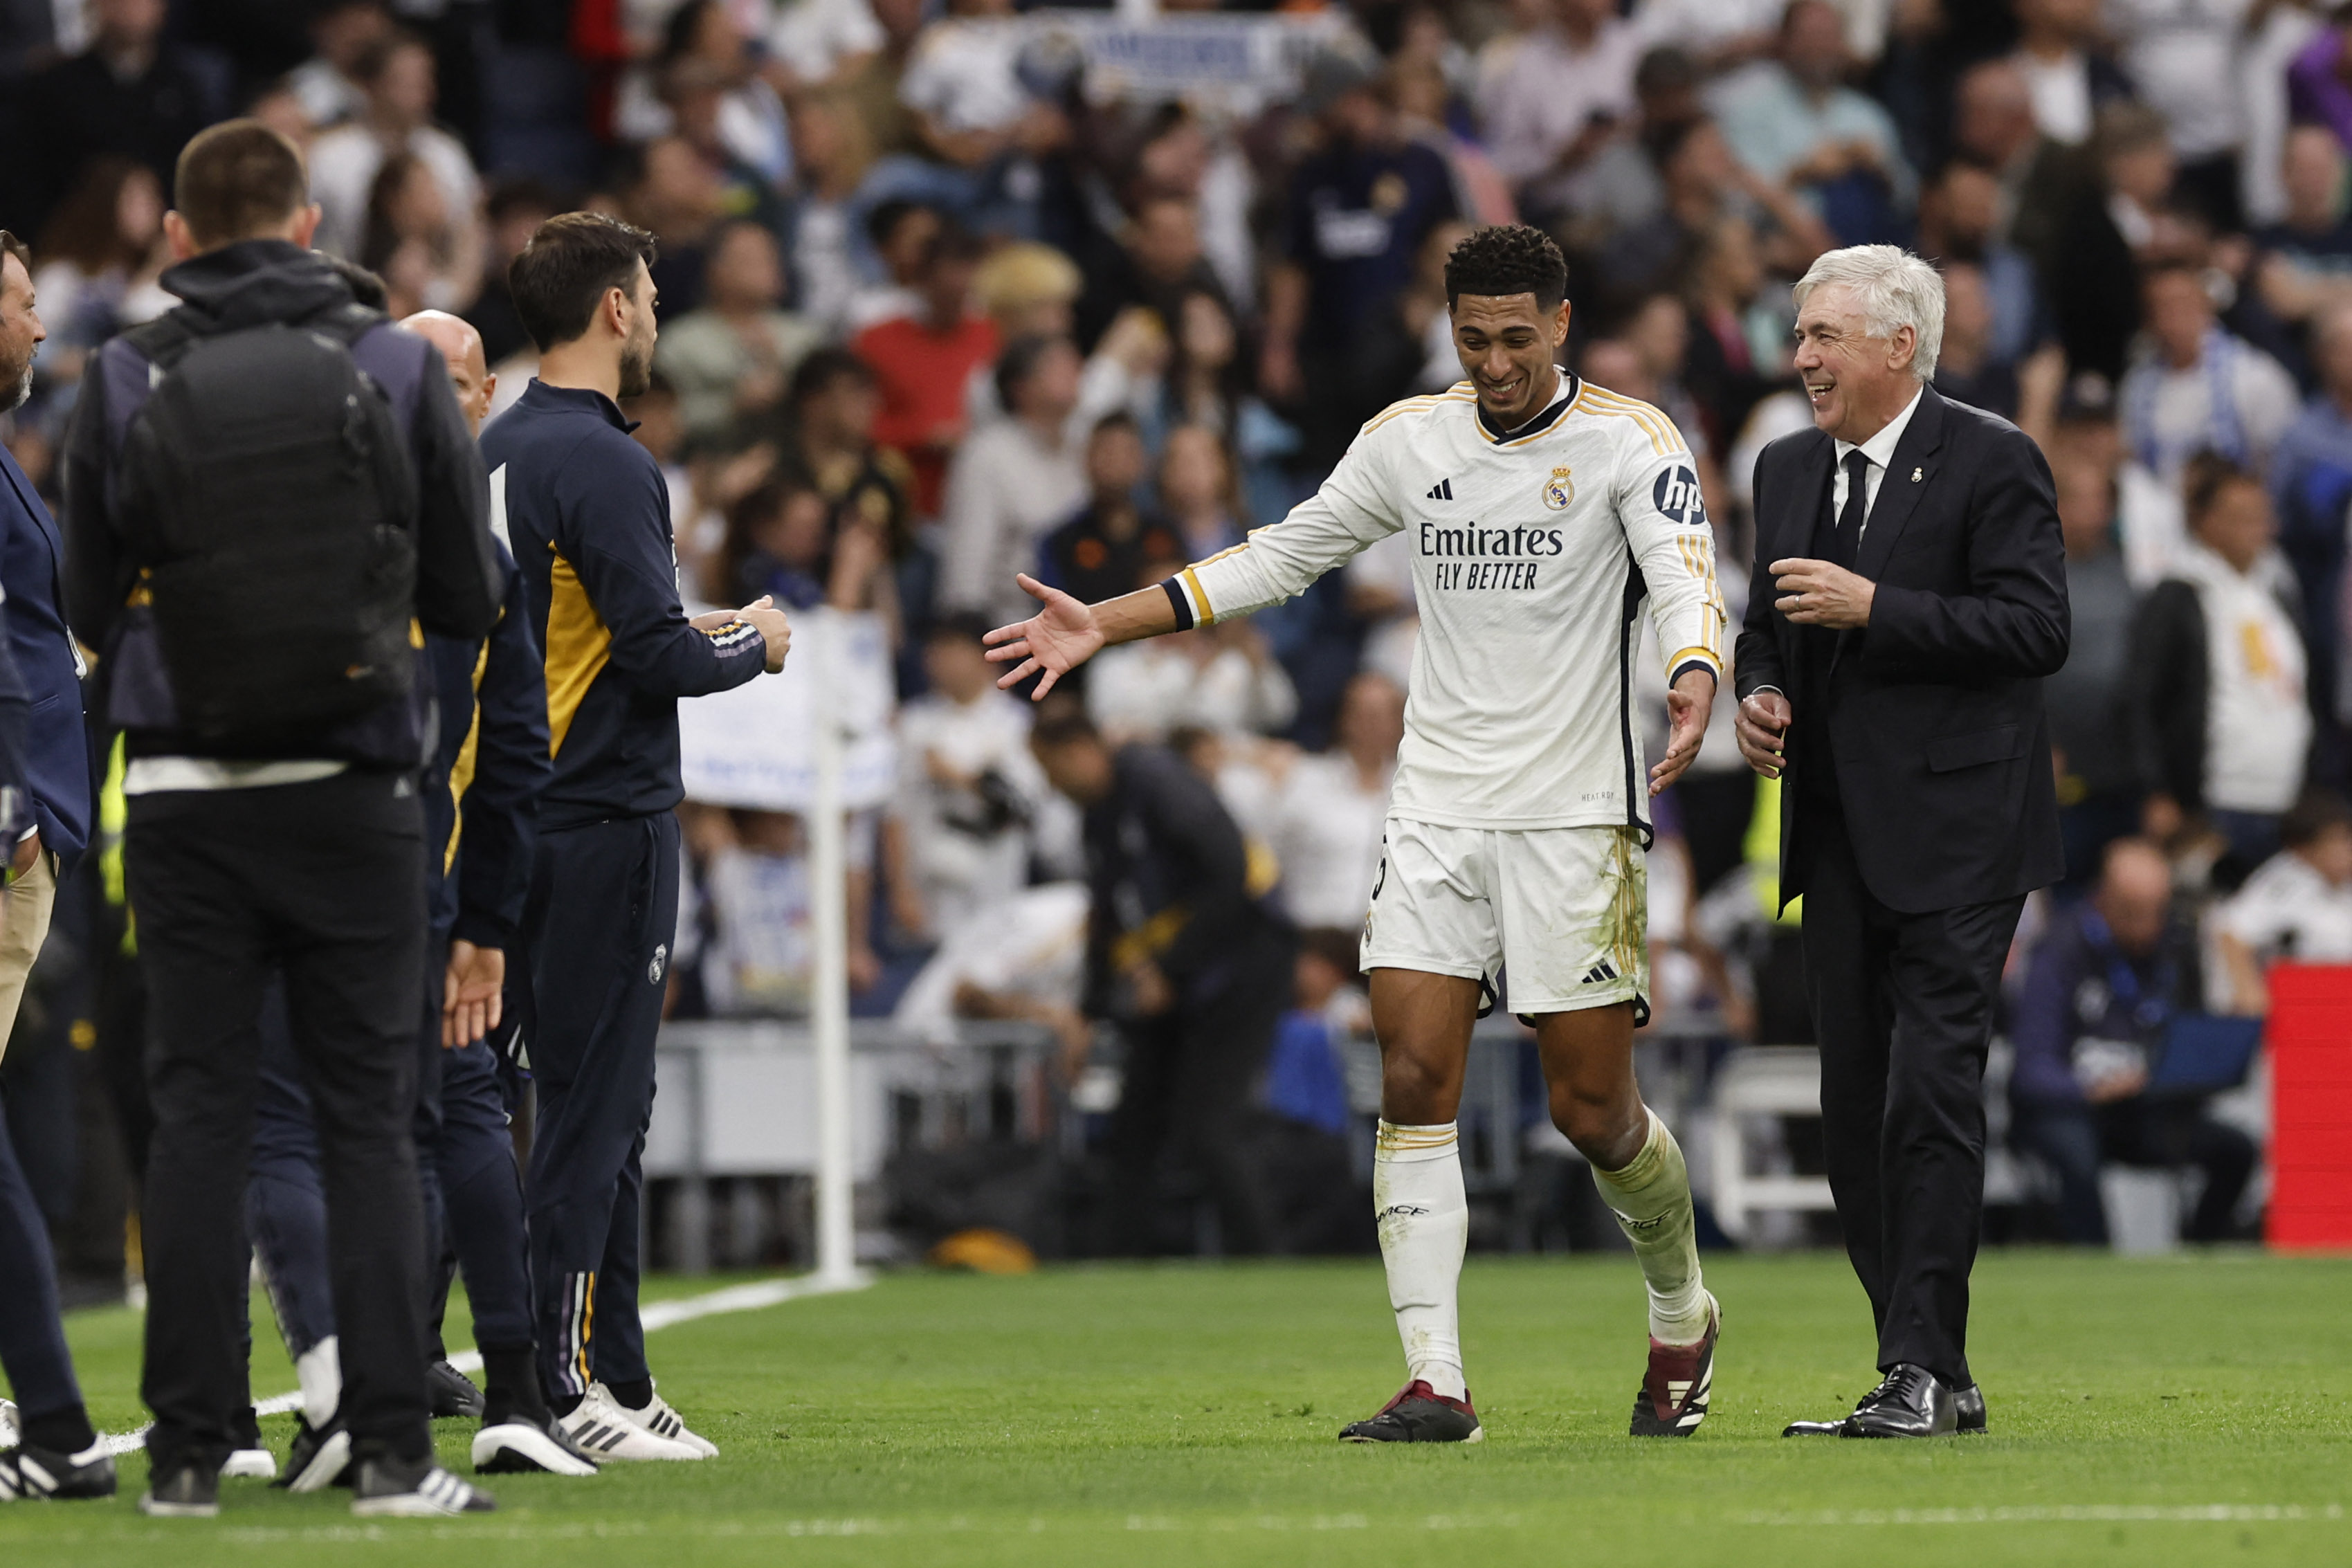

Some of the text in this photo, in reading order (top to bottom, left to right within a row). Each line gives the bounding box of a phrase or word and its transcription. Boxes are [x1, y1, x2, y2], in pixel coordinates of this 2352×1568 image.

[1661, 465, 1702, 524] hp
[1421, 521, 1563, 556] Emirates
[1436, 563, 1538, 590] FLY BETTER
